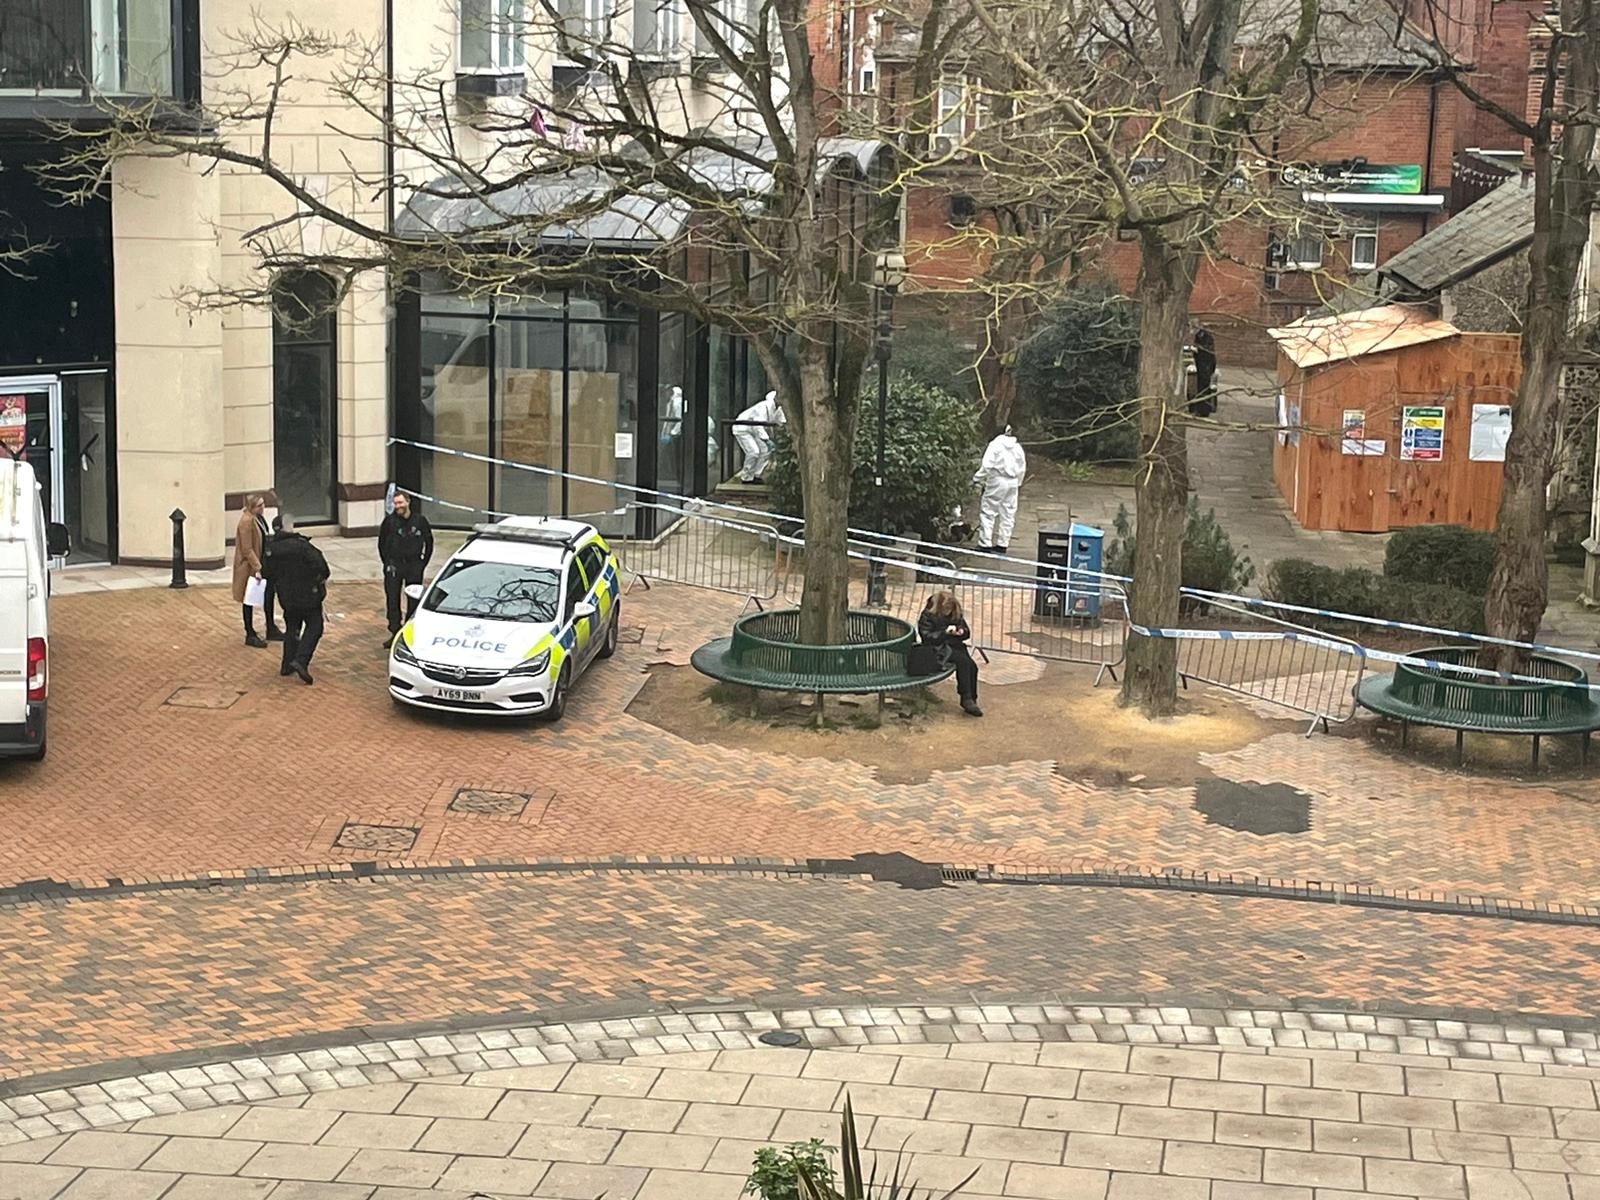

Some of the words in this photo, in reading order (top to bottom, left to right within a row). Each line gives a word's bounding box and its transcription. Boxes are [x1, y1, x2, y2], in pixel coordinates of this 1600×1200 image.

[432, 636, 508, 653] POLICE
[437, 688, 460, 698] AY69
[463, 690, 481, 700] BNN
